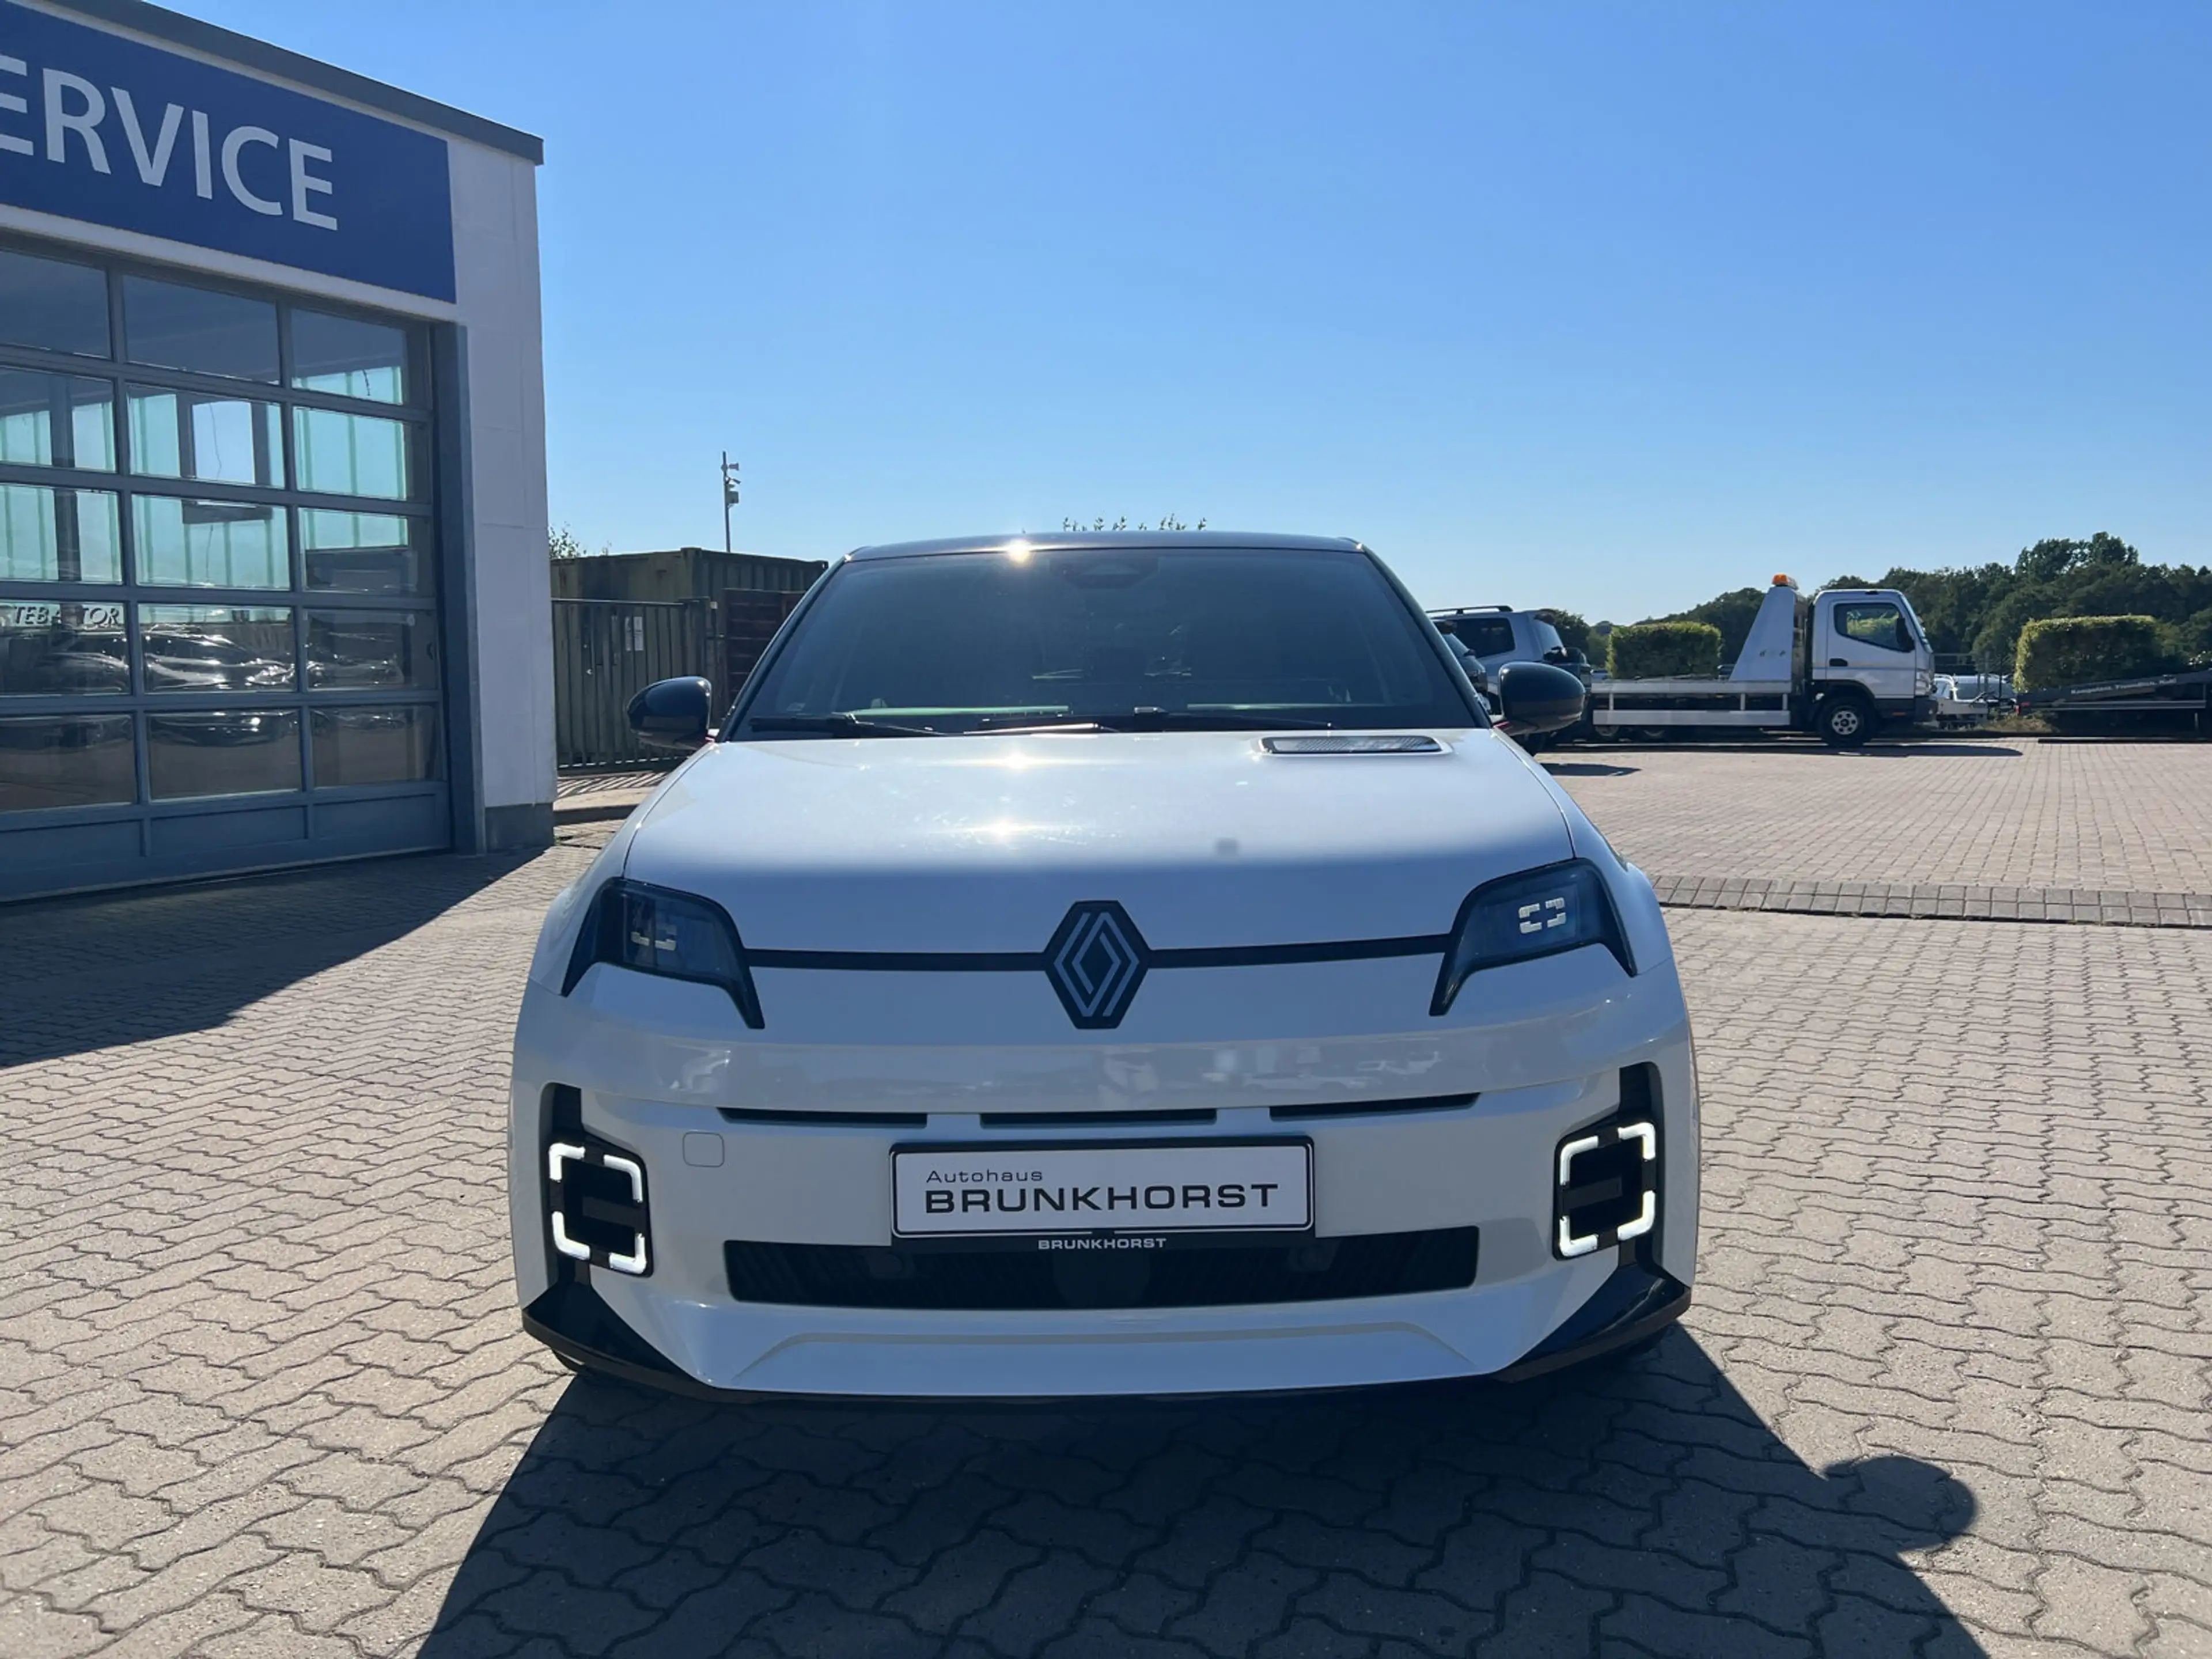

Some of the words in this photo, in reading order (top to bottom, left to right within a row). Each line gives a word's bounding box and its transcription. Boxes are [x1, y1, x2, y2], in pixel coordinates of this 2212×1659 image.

[0, 54, 338, 231] ERVICE
[926, 1169, 1043, 1183] Autohaus
[925, 1183, 1278, 1214] BRUNKHORST
[1037, 1237, 1166, 1250] BRUNKHORST
